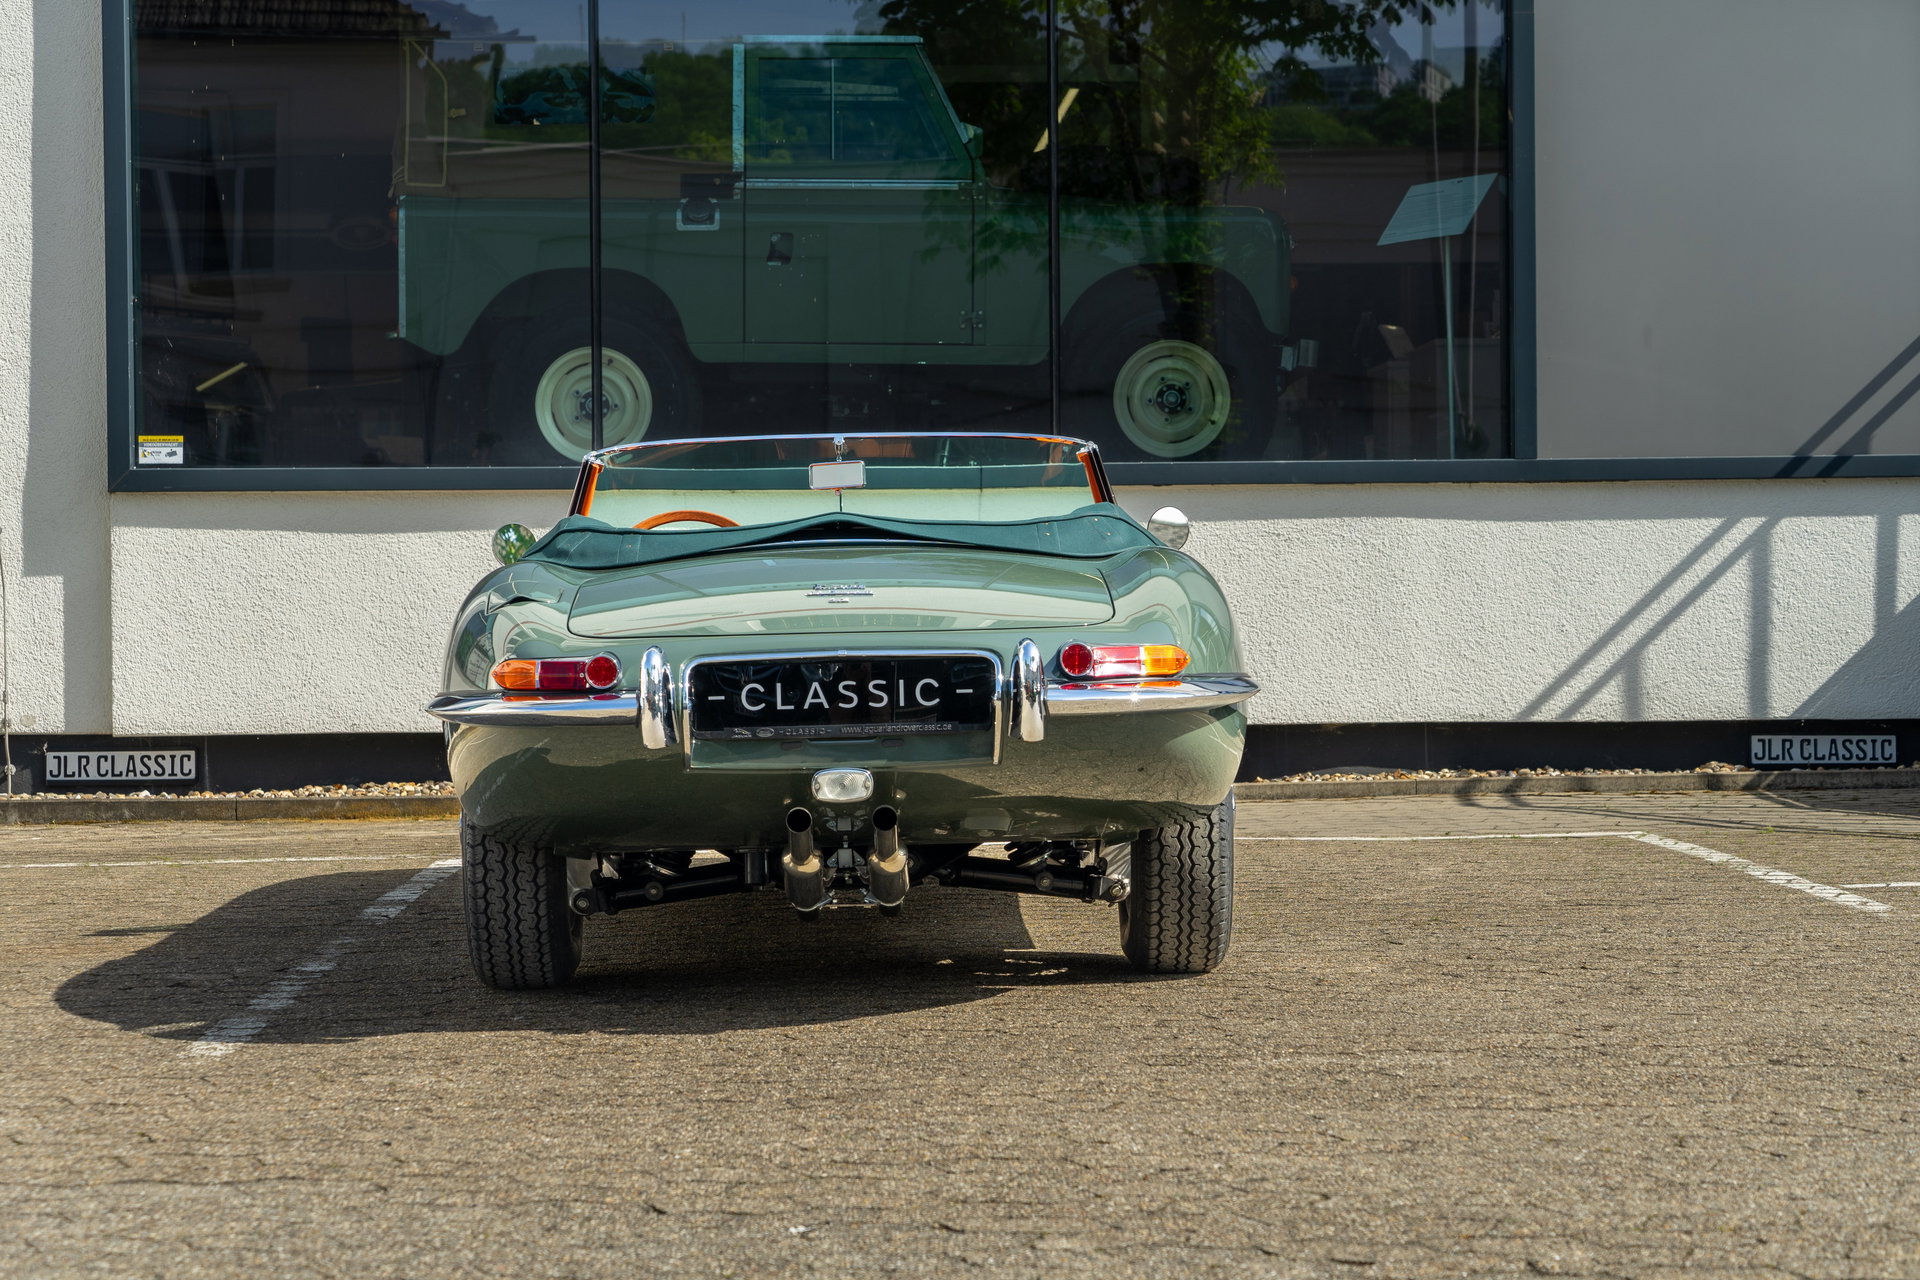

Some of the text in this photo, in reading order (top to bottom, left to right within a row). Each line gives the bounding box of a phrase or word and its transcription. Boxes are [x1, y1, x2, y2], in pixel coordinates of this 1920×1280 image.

[1754, 738, 1893, 761] JLR CLASSIC
[49, 754, 192, 778] JLR CLASSIC
